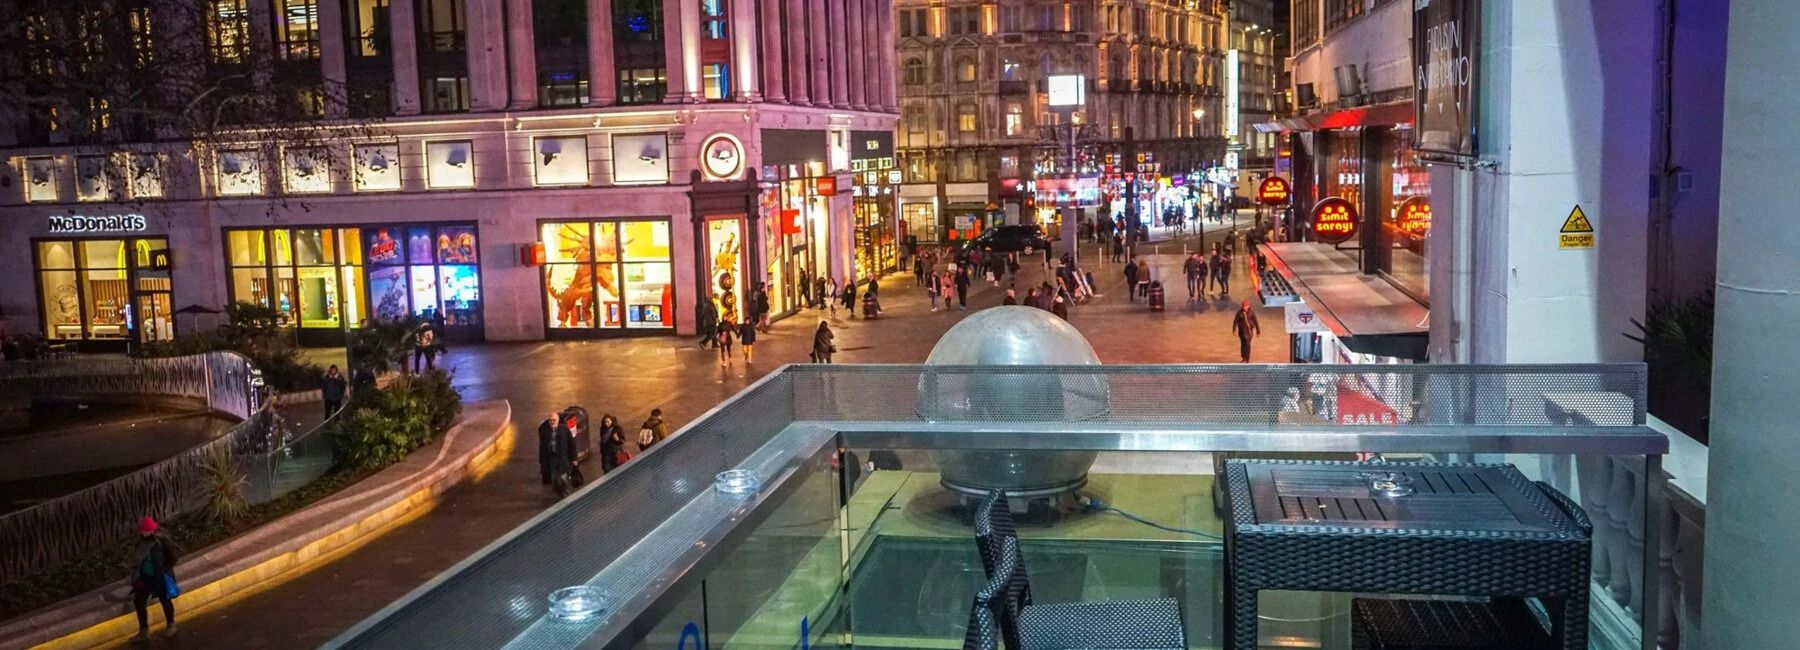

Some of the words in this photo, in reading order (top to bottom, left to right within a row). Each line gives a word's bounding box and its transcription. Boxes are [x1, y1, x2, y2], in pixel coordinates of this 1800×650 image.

[1320, 206, 1349, 221] simit
[48, 214, 146, 233] McDonald's
[1561, 235, 1592, 243] Danger
[1342, 412, 1393, 425] SALE
